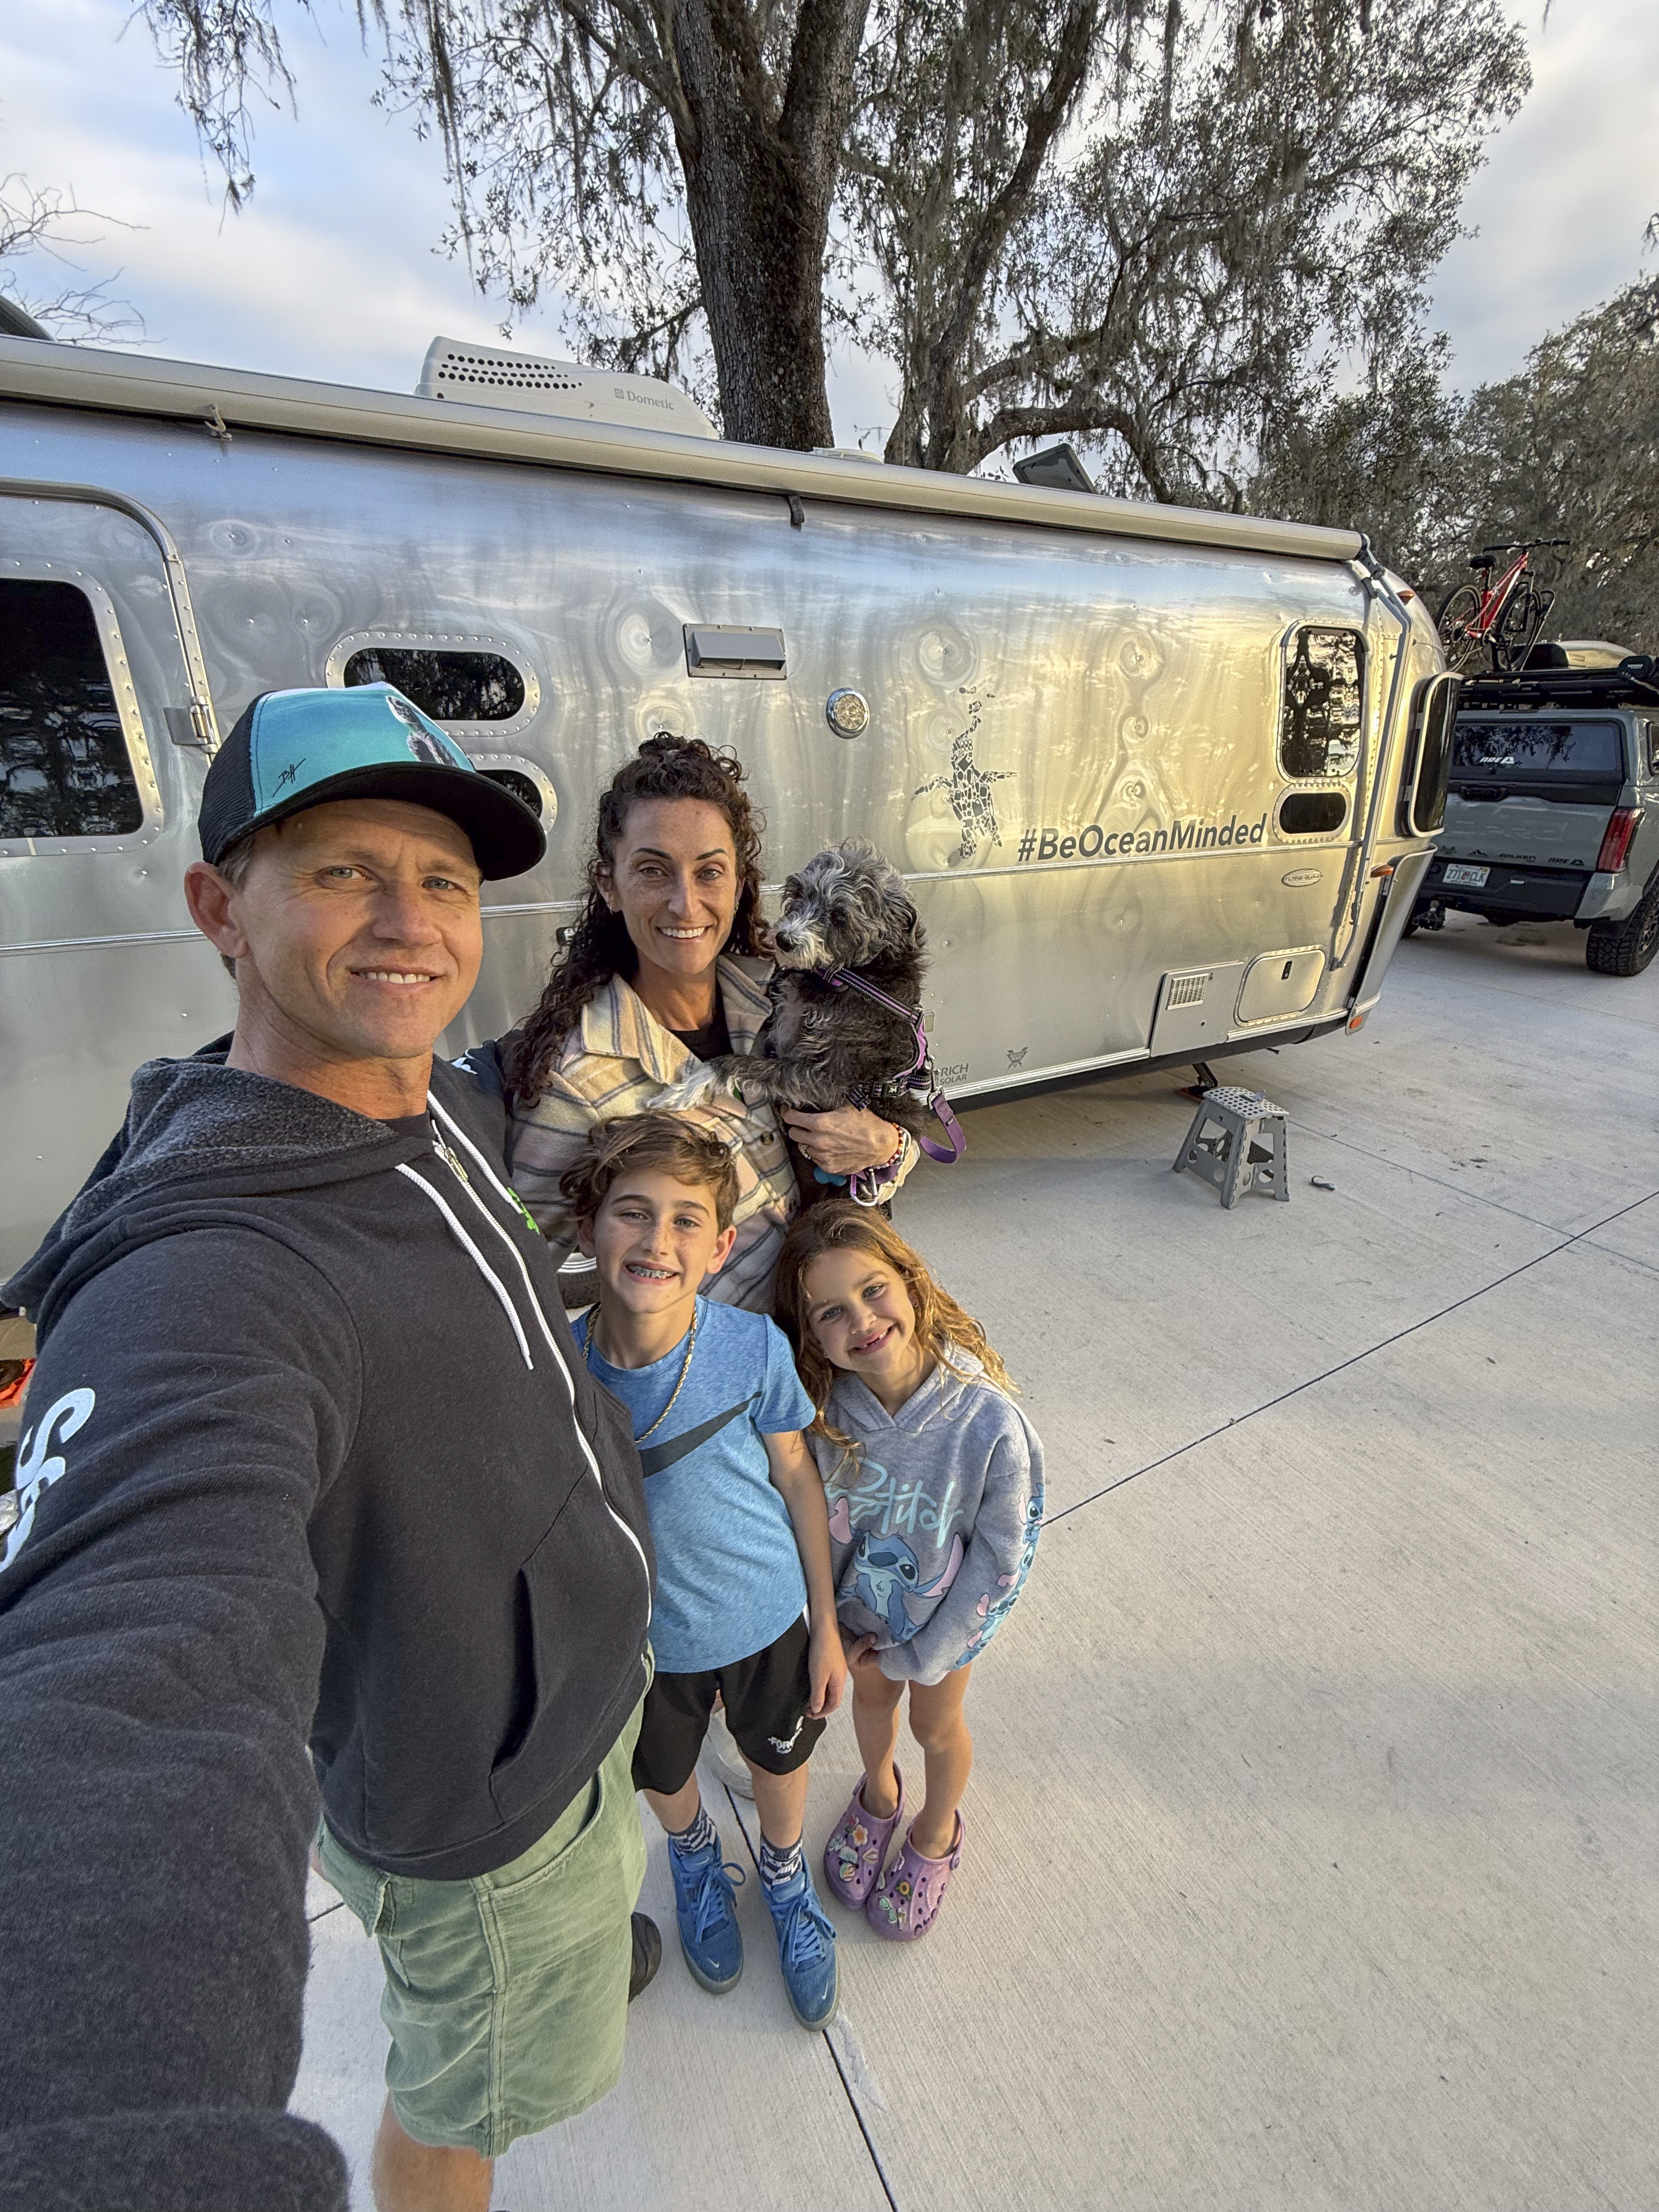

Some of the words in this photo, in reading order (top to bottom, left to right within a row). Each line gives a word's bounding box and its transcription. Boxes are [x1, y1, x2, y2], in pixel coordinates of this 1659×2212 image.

[627, 390, 674, 410] Dometic
[1018, 812, 1268, 862] #BeOceanMinded
[939, 1074, 968, 1086] SOLAR
[940, 1063, 969, 1077] RICH
[824, 1456, 964, 1549] Stitch
